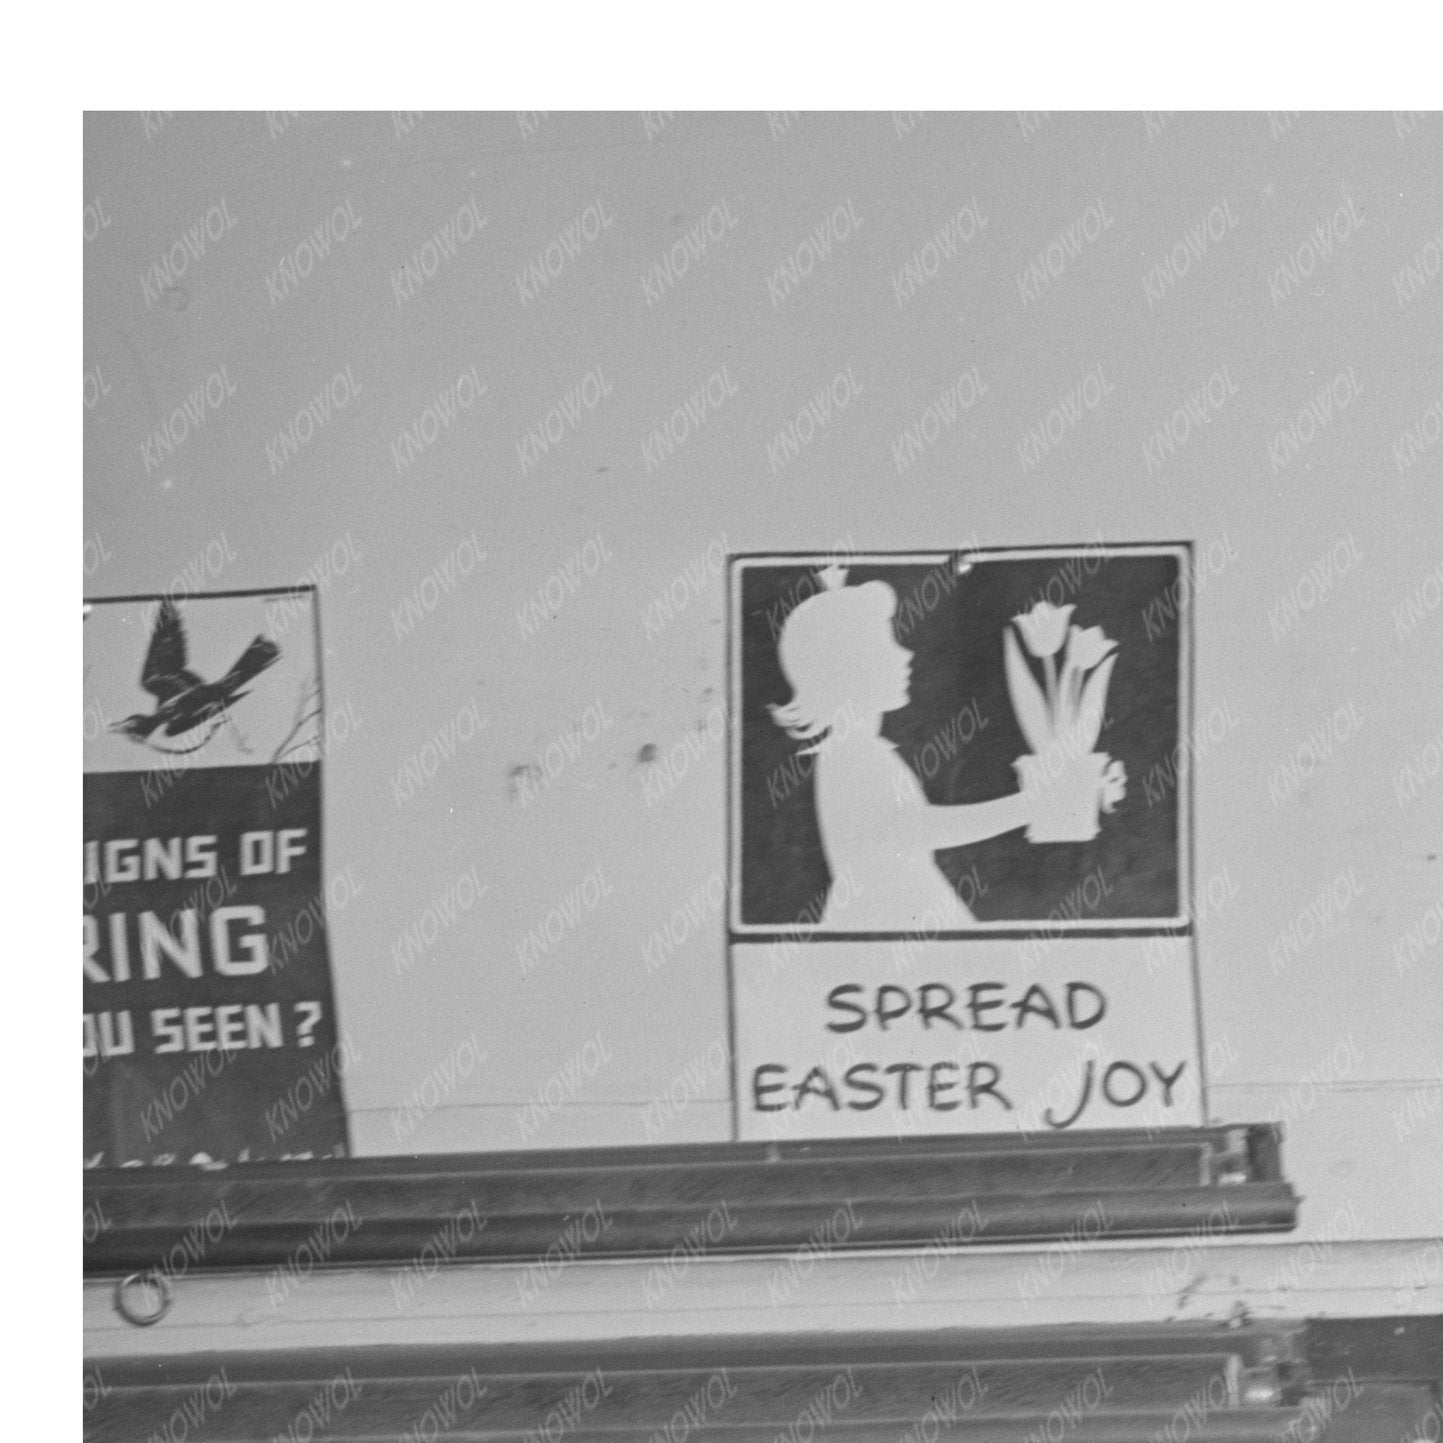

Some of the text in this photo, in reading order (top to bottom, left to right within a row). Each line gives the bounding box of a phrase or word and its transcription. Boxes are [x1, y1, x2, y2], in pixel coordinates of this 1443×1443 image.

[83, 828, 307, 884] IGNS OF
[825, 980, 1107, 1034] SPREAD
[752, 1059, 1187, 1129] EASTER JOY
